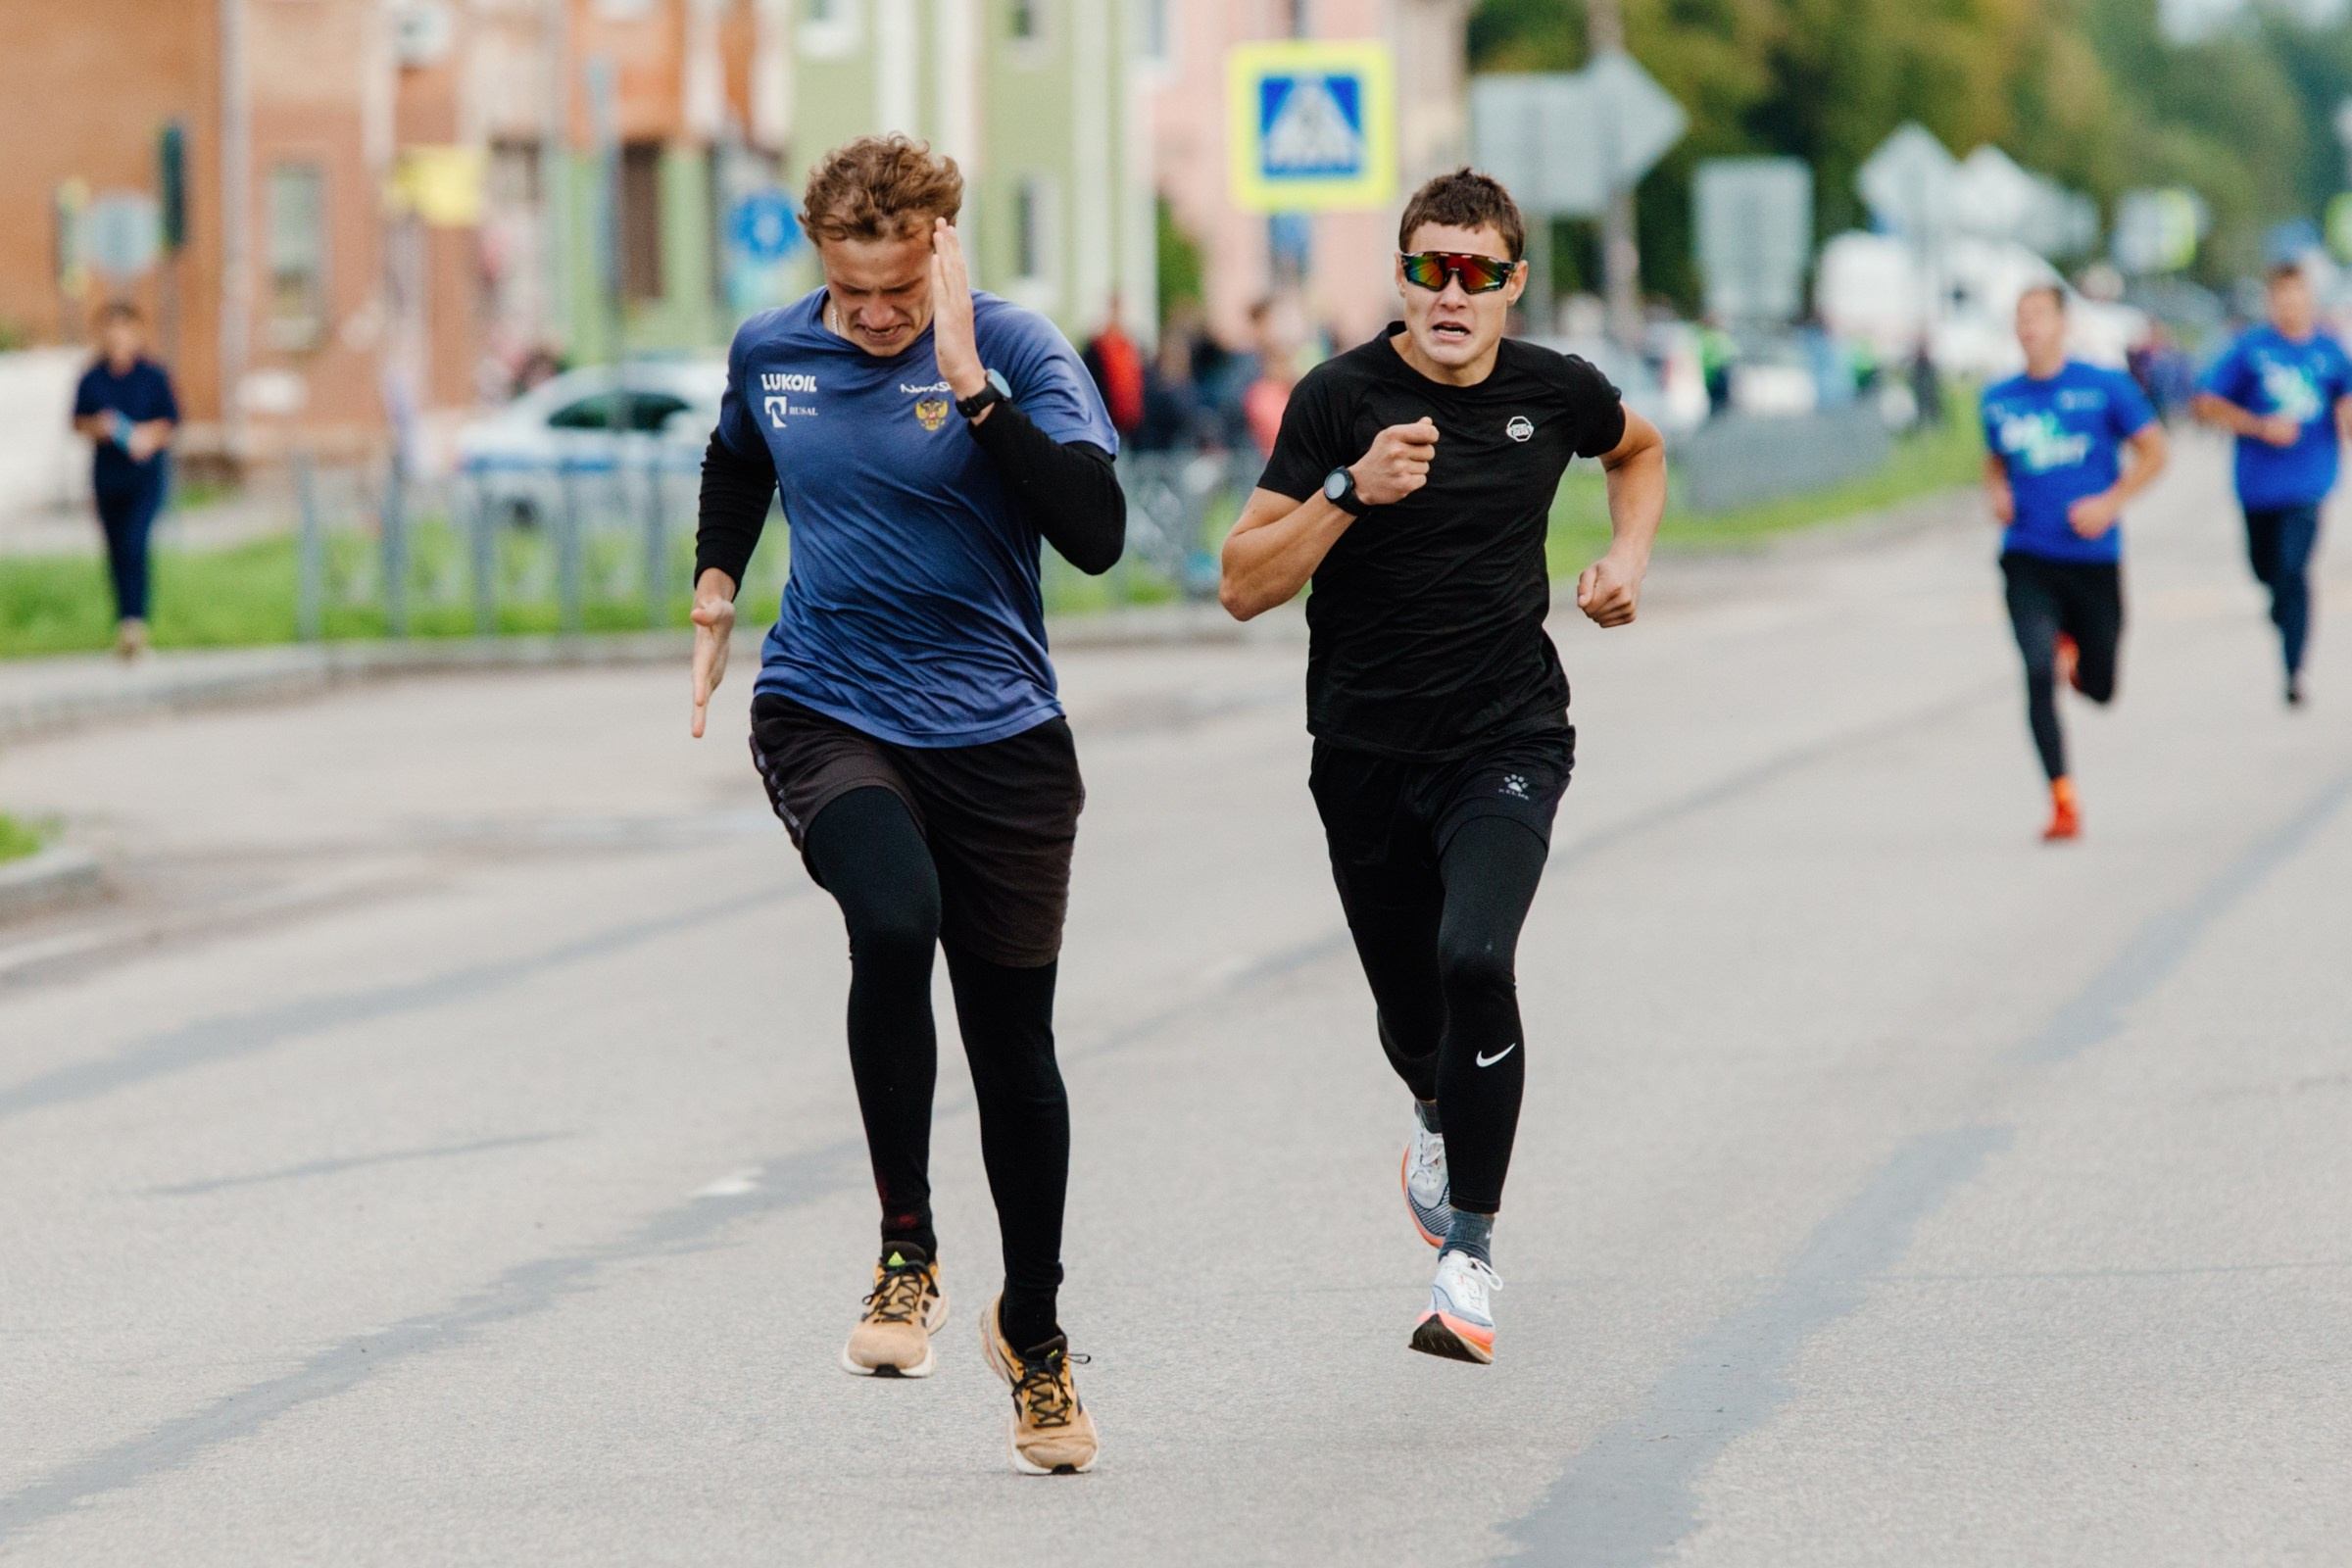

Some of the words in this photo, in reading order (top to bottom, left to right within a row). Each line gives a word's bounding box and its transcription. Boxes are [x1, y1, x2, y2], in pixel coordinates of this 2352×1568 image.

[760, 373, 817, 392] LUKOIL
[900, 381, 952, 393] NordS
[789, 406, 818, 416] RUSAL
